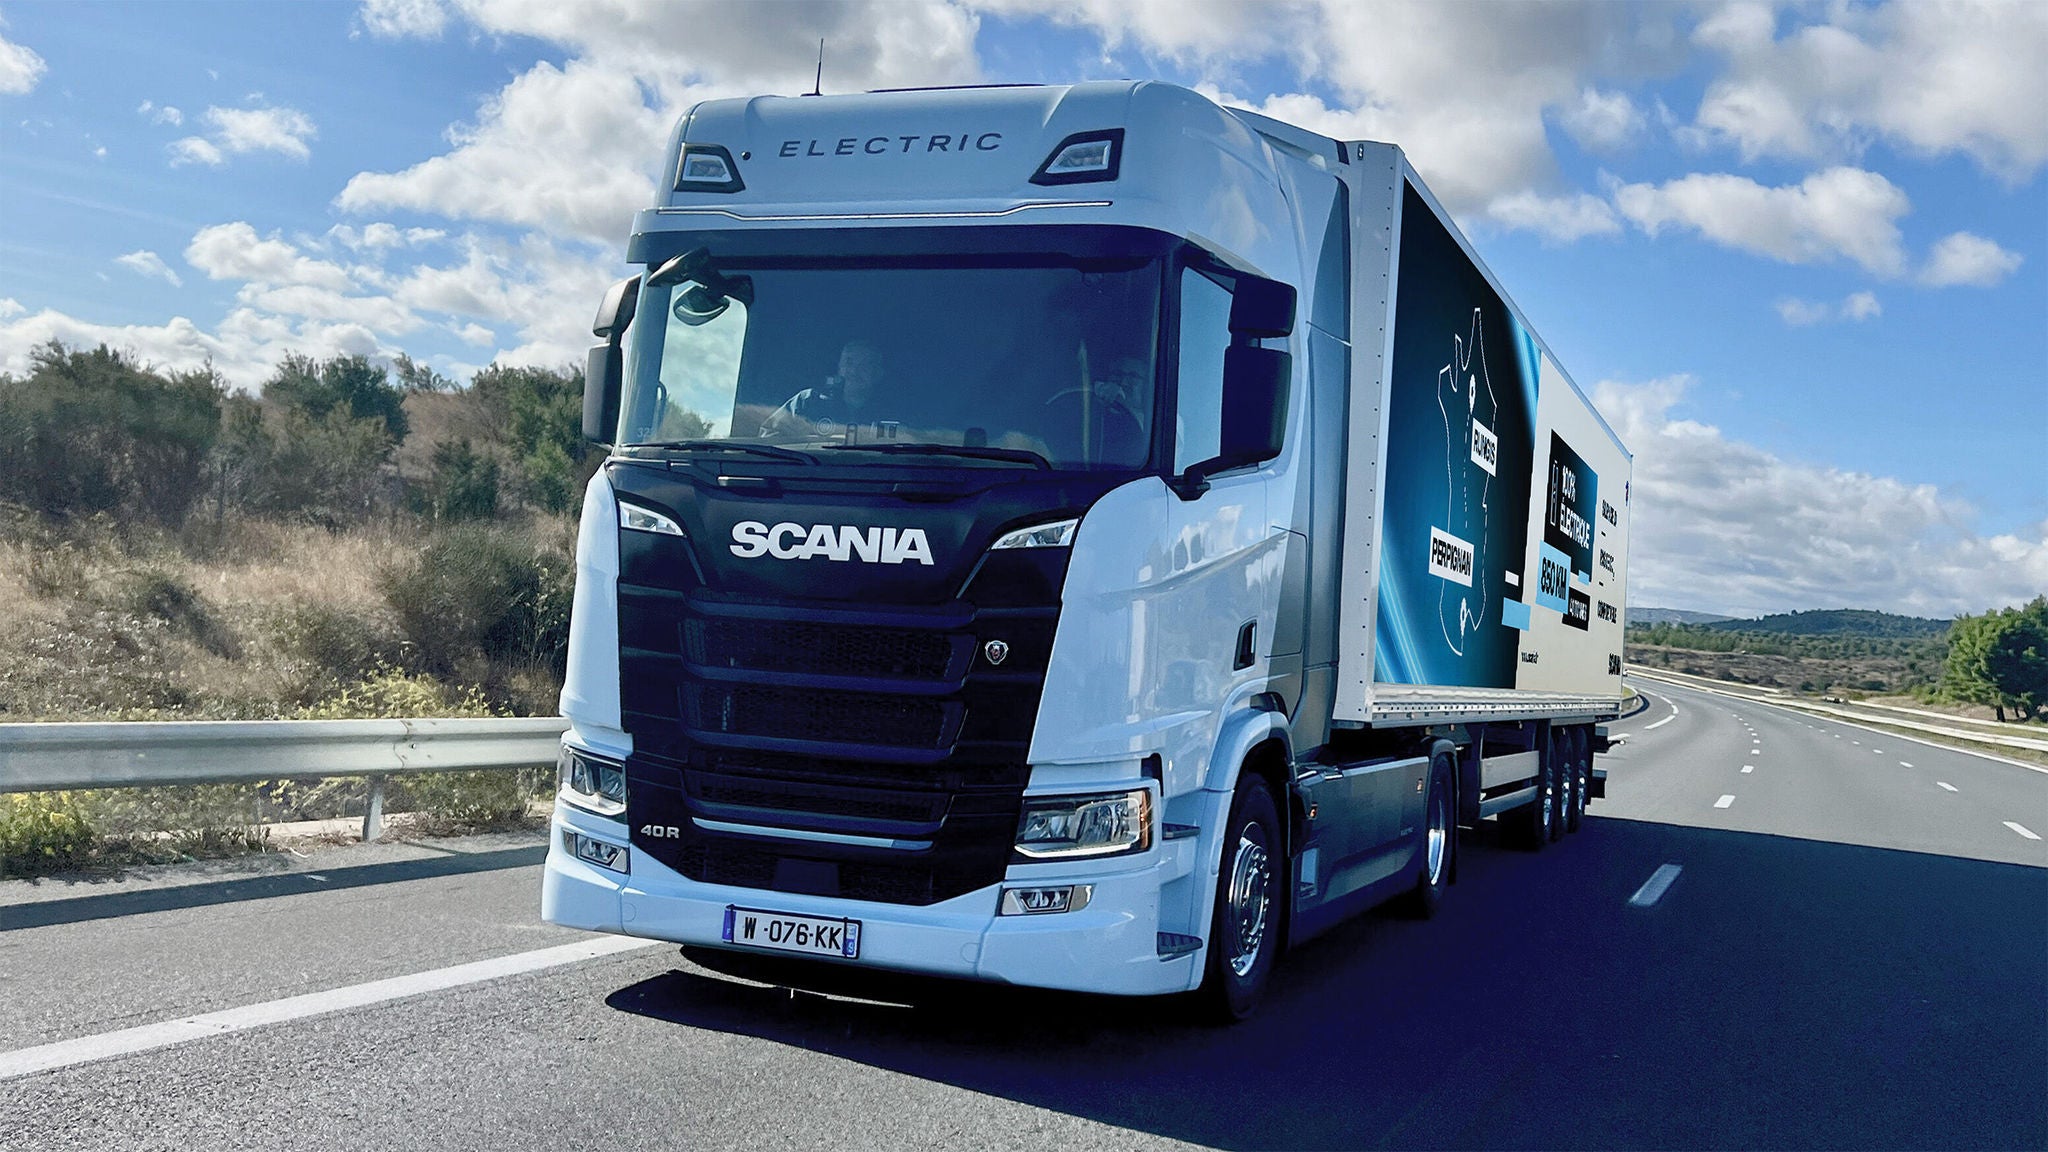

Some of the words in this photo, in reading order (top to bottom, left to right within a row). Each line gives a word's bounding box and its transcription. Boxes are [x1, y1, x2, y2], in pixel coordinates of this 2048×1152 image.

[778, 132, 1002, 157] ELECTRIC
[1473, 429, 1496, 466] RUNGIS
[729, 520, 934, 566] SCANIA
[1431, 536, 1472, 577] PERPIGNAN
